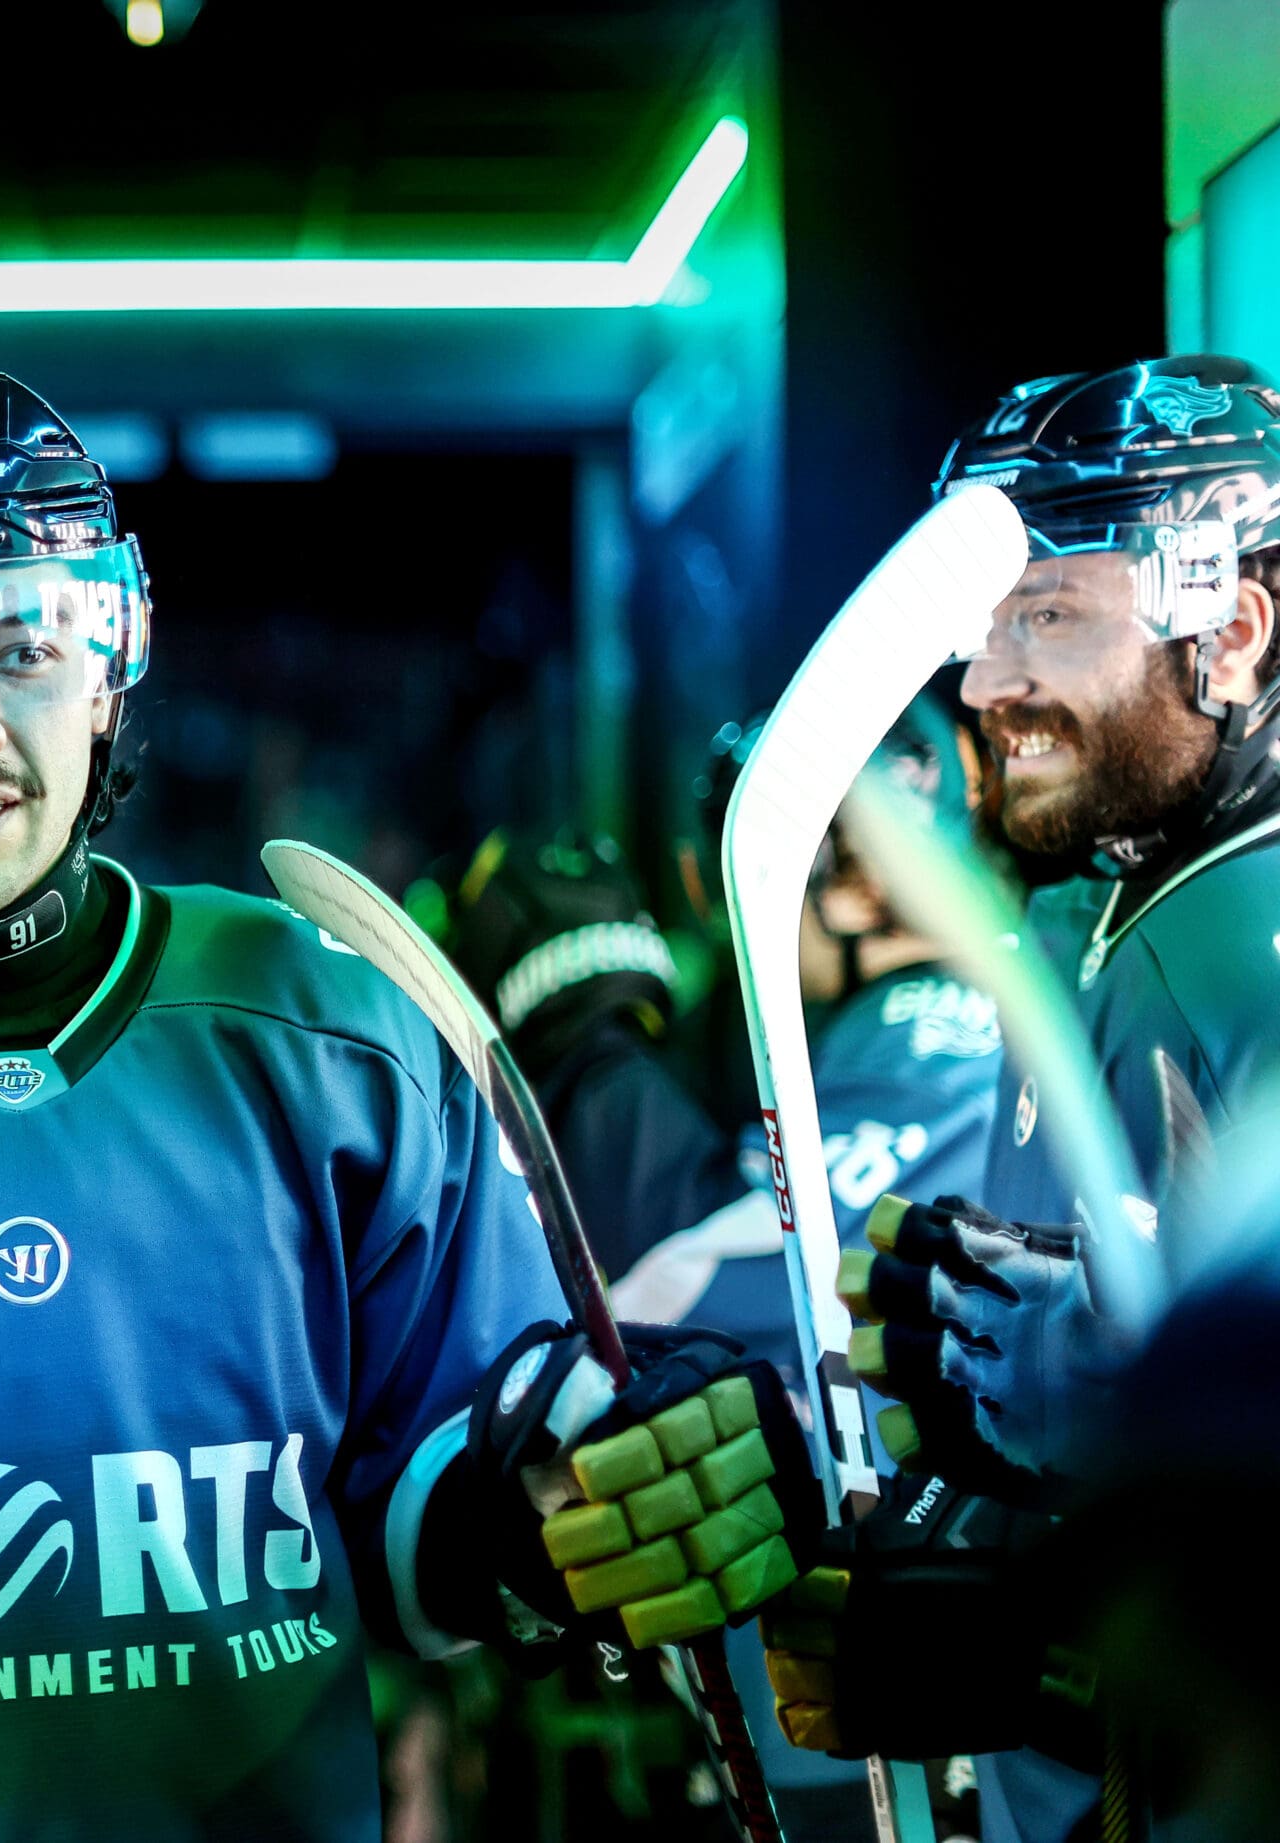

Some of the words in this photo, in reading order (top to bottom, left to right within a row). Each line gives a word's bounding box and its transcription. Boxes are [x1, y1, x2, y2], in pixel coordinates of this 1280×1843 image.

[9, 913, 37, 950] 91
[763, 1116, 793, 1224] CCM
[904, 1476, 945, 1524] ALPHA
